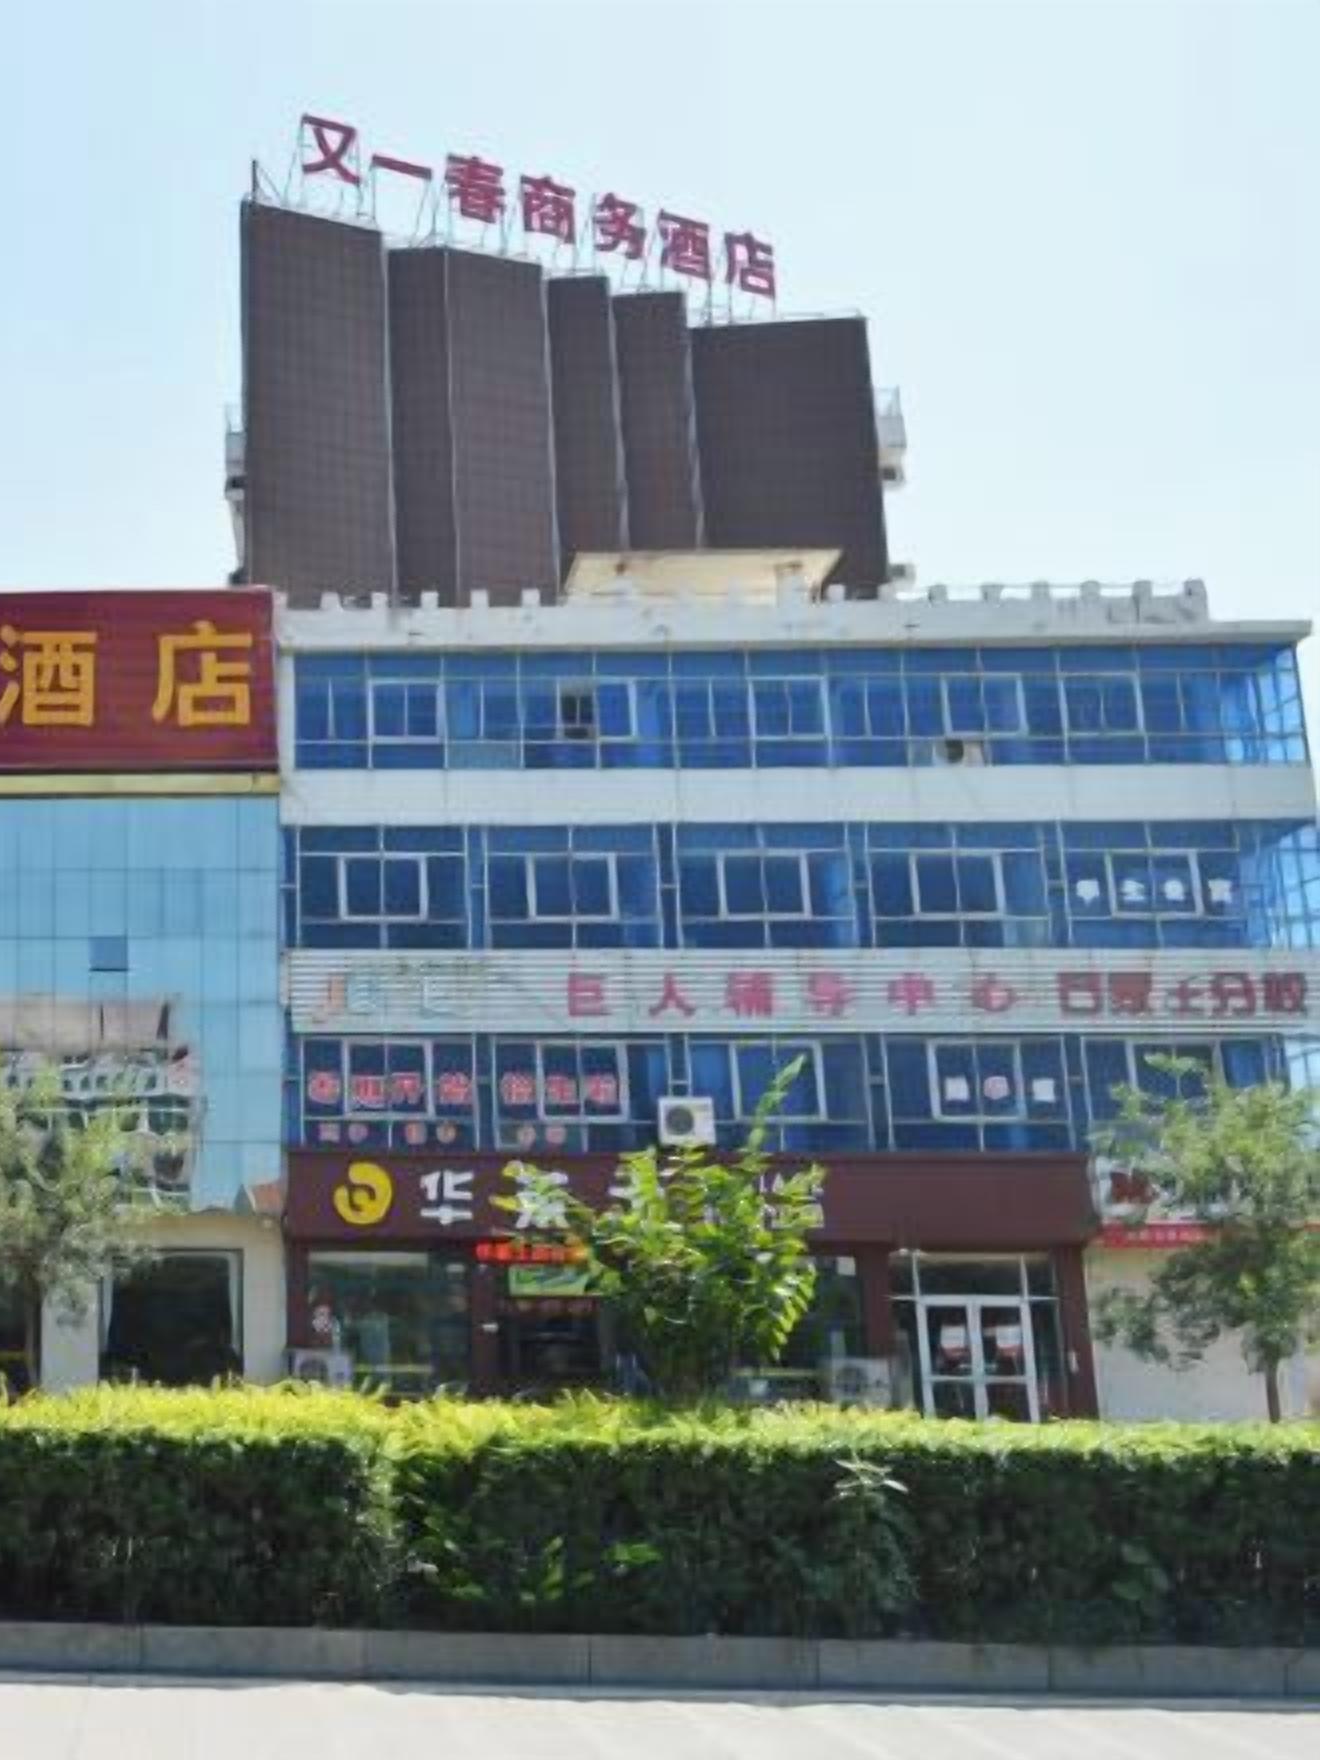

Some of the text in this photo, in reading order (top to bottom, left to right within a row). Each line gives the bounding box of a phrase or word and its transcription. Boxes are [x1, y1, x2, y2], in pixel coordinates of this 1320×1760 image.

[300, 113, 776, 299] 又一春商务酒店
